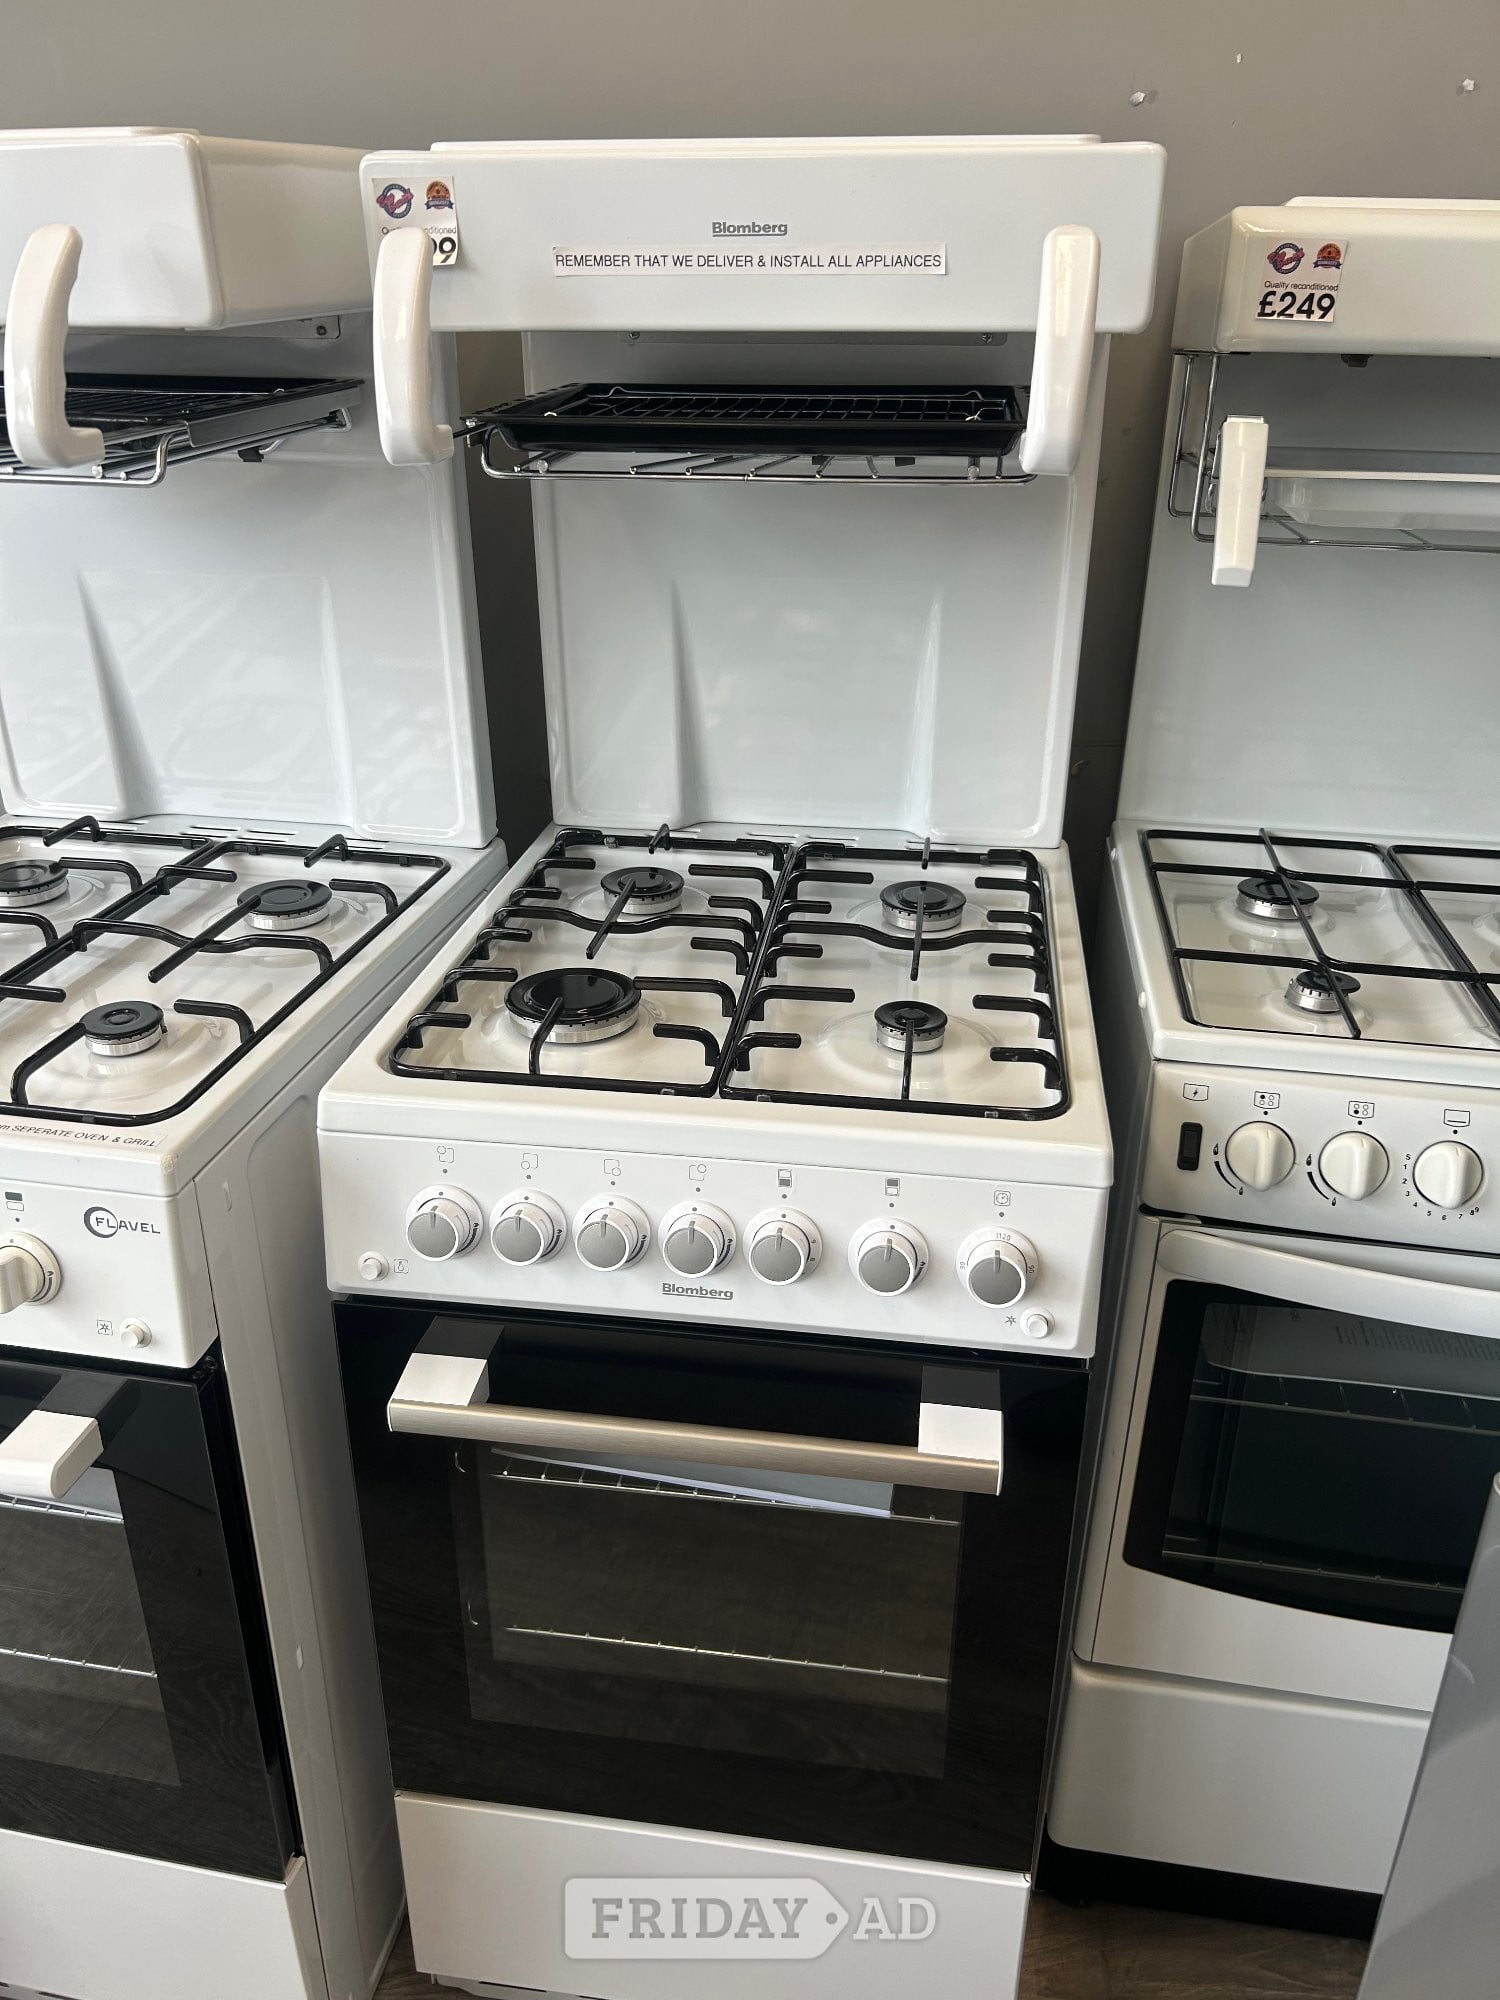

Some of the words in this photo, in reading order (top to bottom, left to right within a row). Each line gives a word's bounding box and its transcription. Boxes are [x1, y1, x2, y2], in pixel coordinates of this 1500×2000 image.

[712, 222, 788, 237] Blomberg
[555, 254, 631, 267] REMEMBER
[634, 254, 669, 267] THAT
[672, 254, 693, 268] WE
[697, 254, 754, 268] DELIVER
[757, 254, 766, 268] &
[770, 254, 825, 268] INSTALL
[828, 254, 852, 268] ALL
[856, 254, 942, 268] APPLIANCES
[1264, 280, 1290, 290] Quality
[1290, 282, 1339, 292] reconditioned
[1257, 290, 1335, 320] £249
[12, 1125, 72, 1138] SEPERATE
[74, 1132, 109, 1142] OVEN
[123, 1138, 158, 1147] GRILL
[662, 1282, 734, 1301] Blomberg
